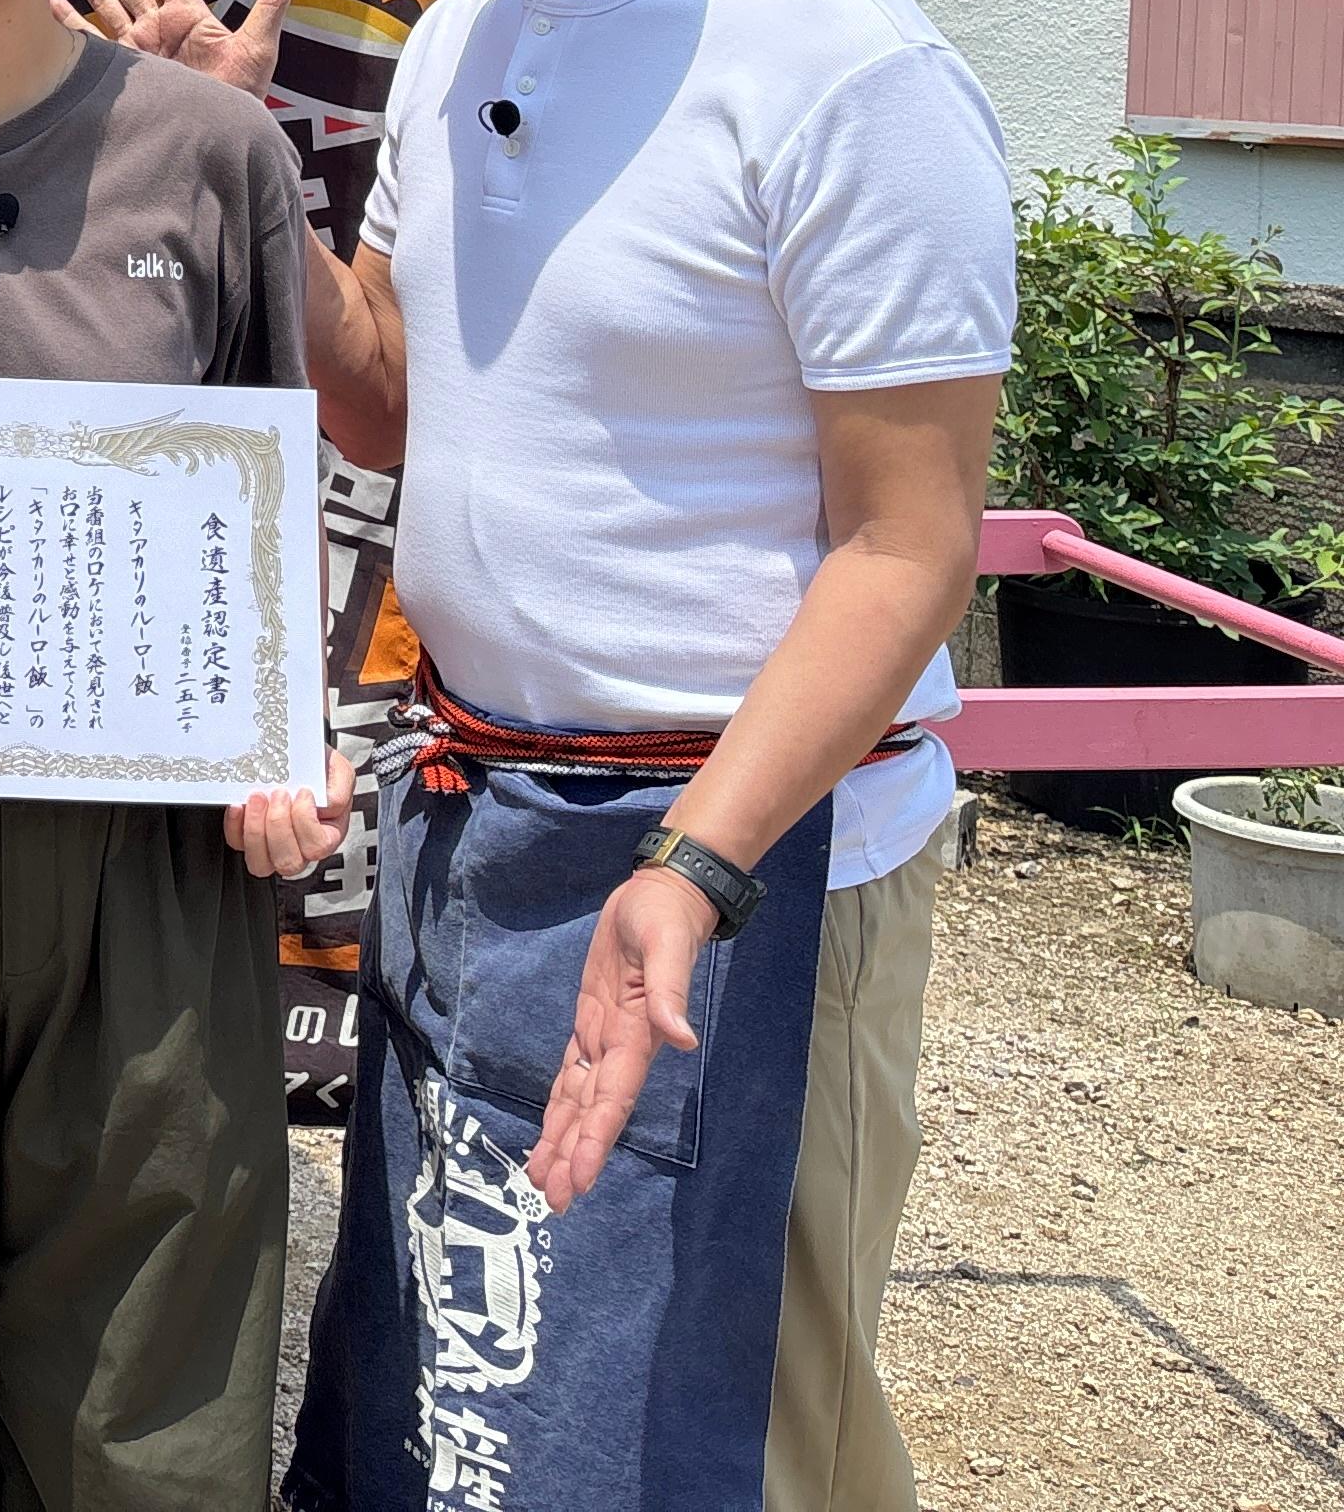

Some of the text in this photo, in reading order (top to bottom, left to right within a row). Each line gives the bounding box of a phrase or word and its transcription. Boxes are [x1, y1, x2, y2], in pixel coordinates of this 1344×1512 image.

[127, 252, 164, 278] talk
[58, 486, 80, 728] お口に幸せと感動を与えてくれた
[86, 486, 107, 729] 当番組のロケにおいて発見され
[129, 500, 158, 696] キタアカリのルーロー飯
[201, 513, 230, 704] 食遺産認定書
